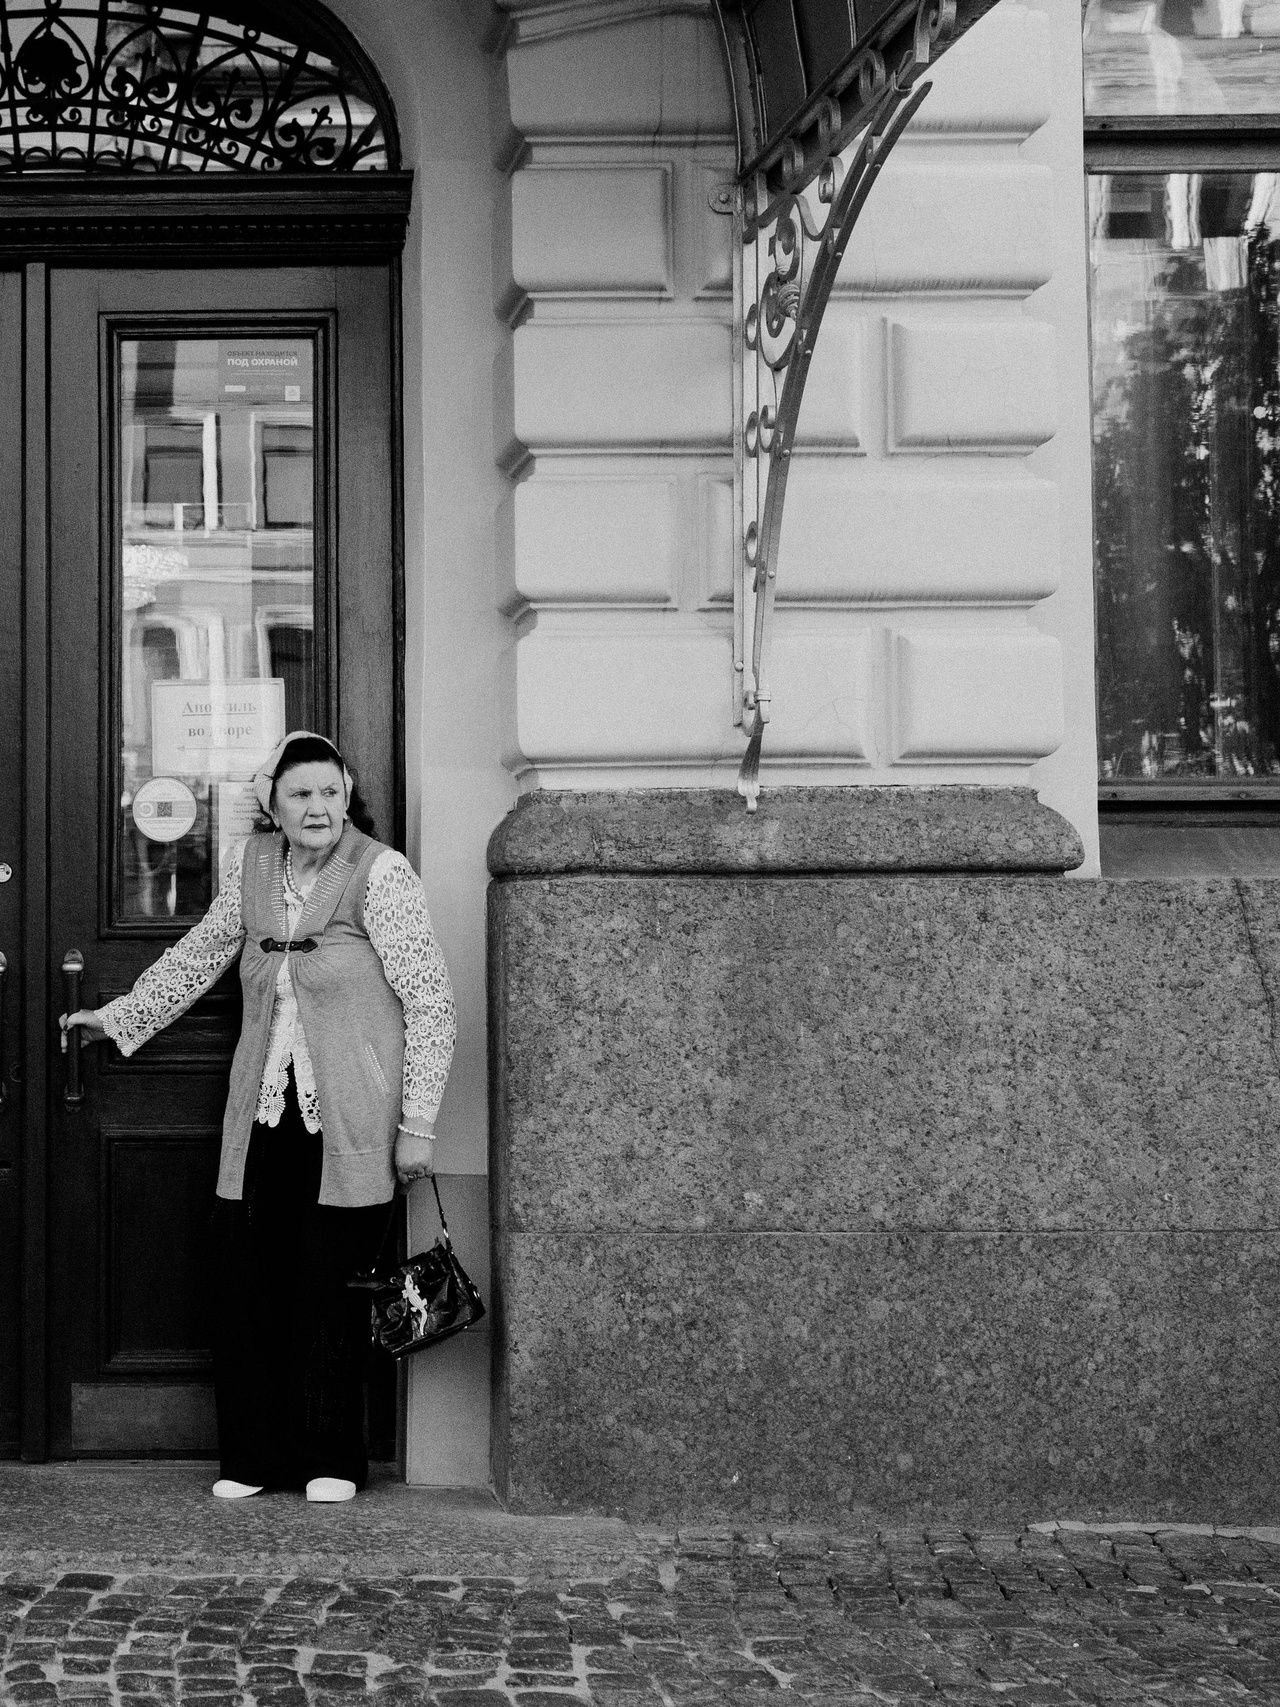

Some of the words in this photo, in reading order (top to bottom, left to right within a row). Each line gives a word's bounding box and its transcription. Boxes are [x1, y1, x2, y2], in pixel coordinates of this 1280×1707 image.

[227, 358, 249, 367] ПОД
[251, 356, 298, 366] ОХРАНОЙ
[188, 727, 205, 737] во
[208, 725, 253, 739] оре
